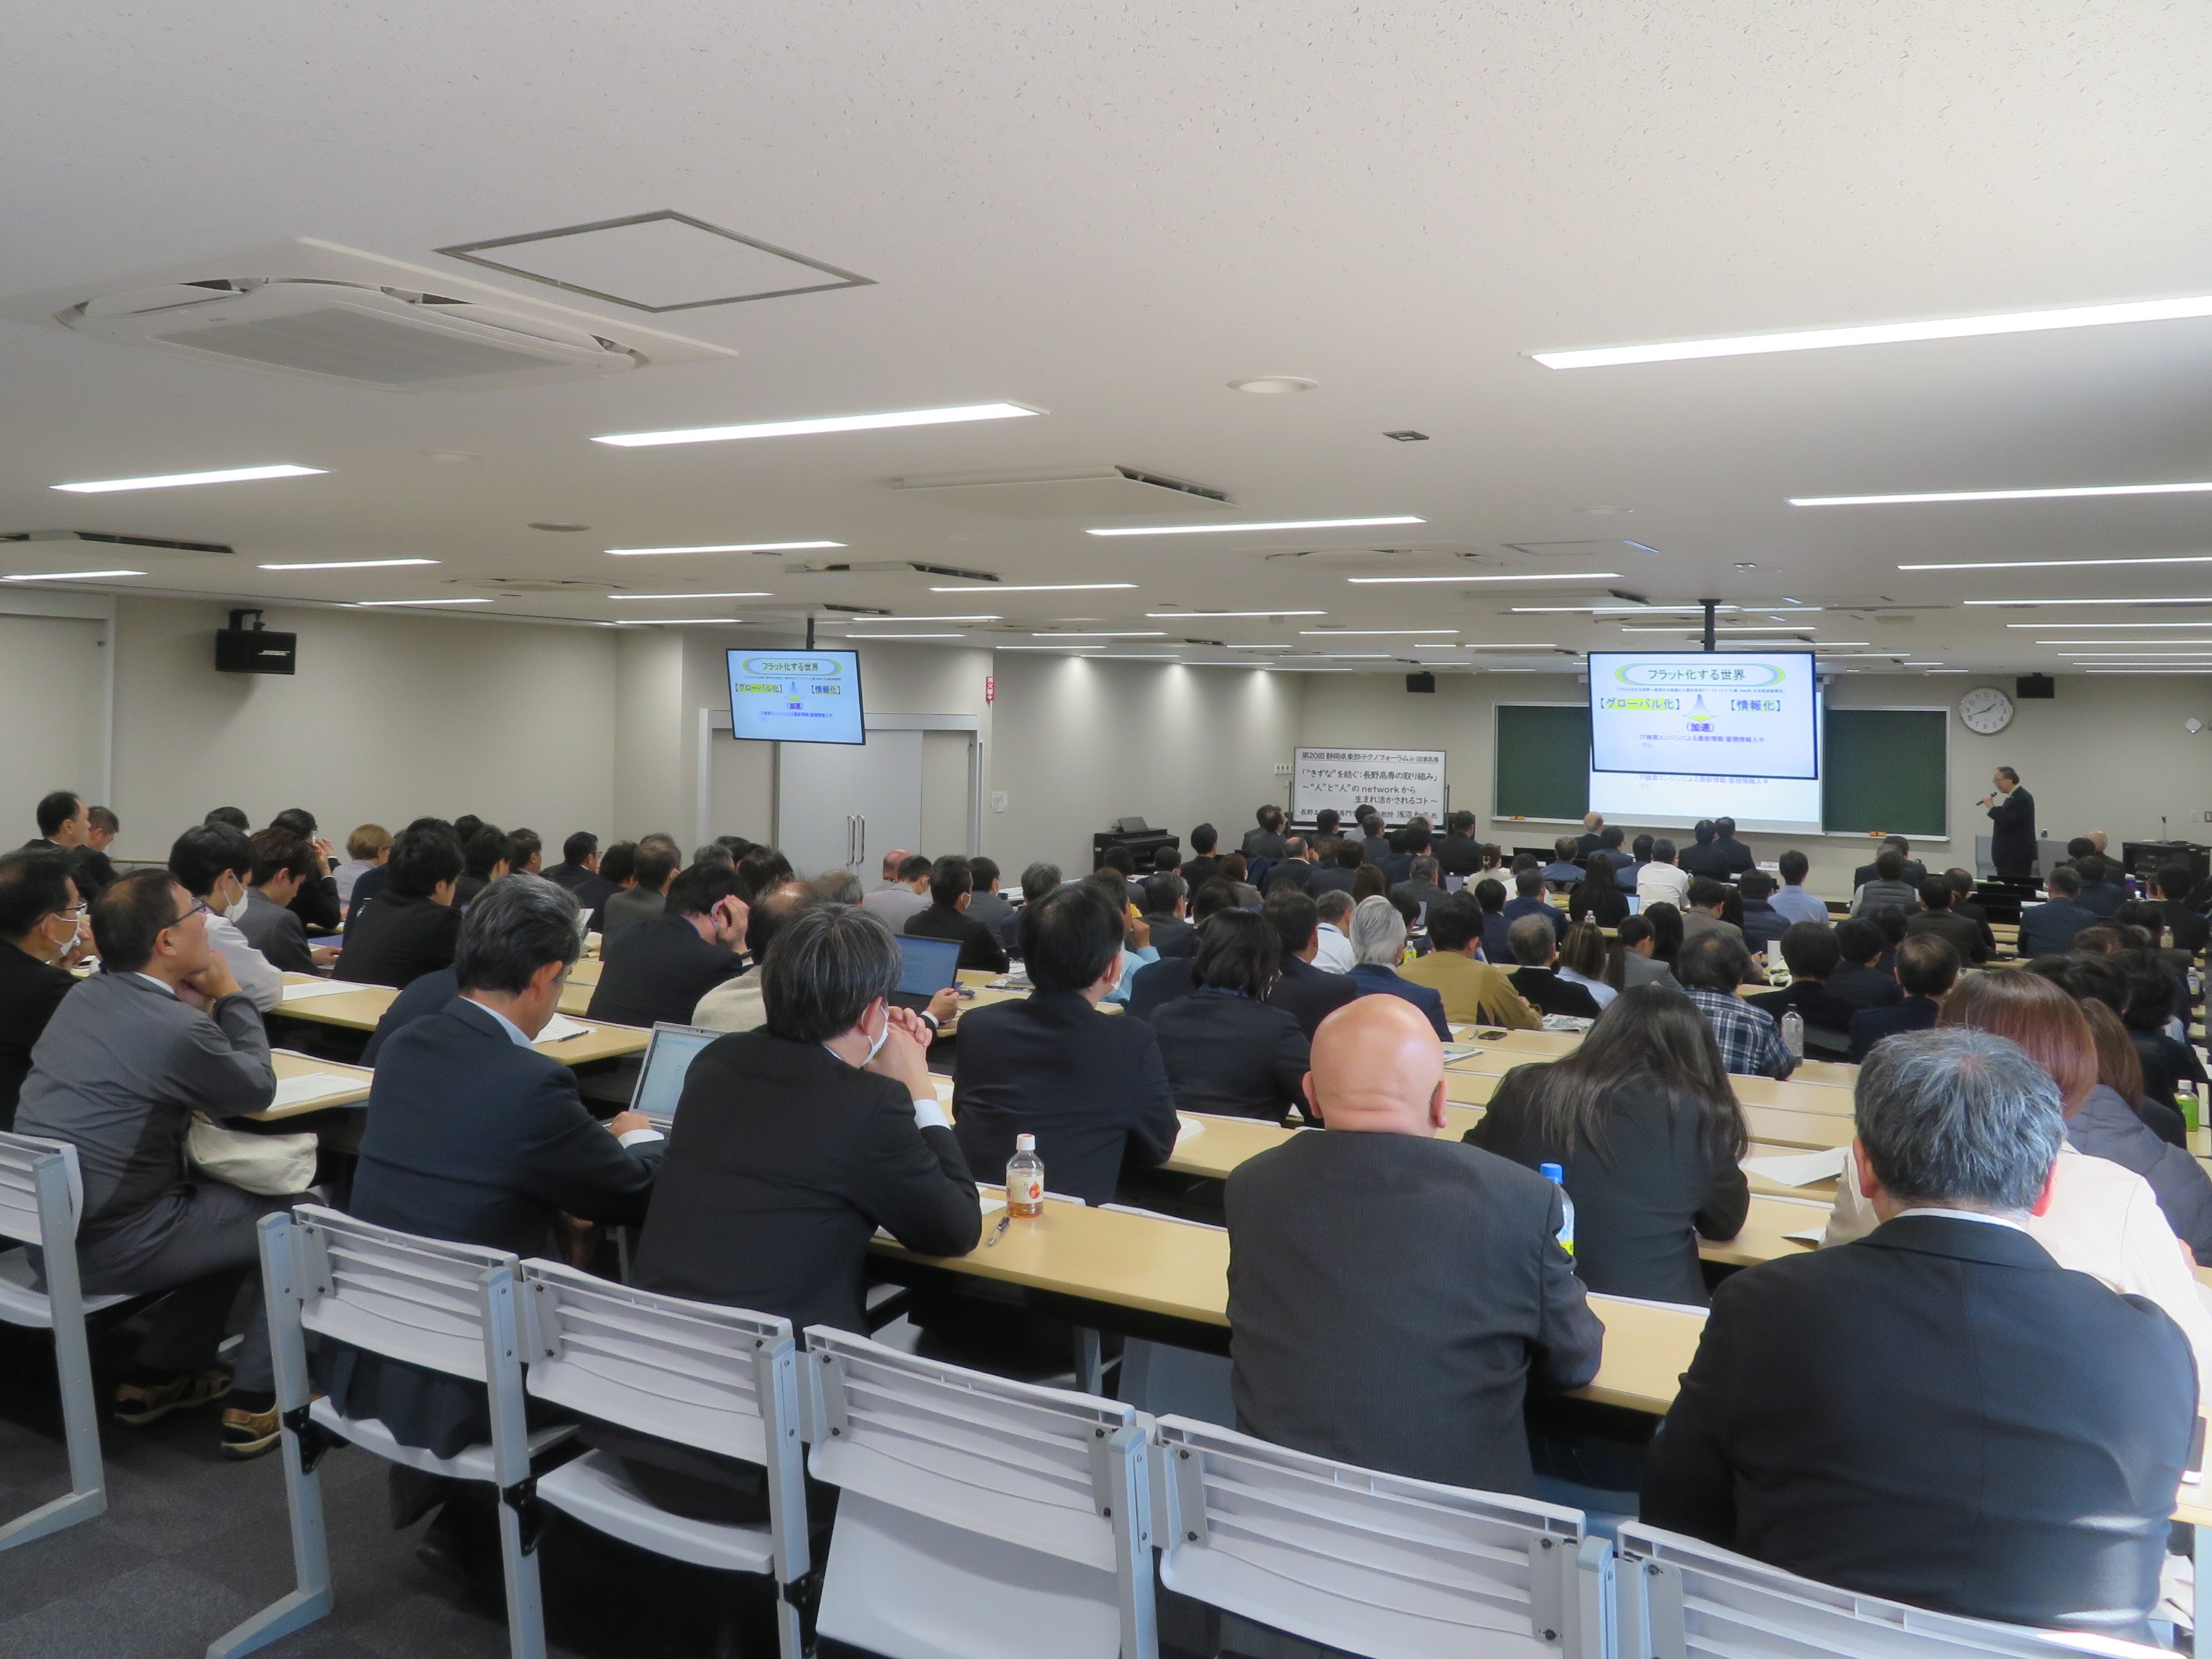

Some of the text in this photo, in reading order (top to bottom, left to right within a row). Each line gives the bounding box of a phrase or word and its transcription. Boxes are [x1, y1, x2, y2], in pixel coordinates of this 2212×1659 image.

[762, 662, 820, 671] フラット化する世界
[1648, 668, 1746, 681] フラット化する世界
[735, 683, 783, 693] 【グローバル化】
[1600, 697, 1680, 711] 【グローバル化】
[1730, 699, 1781, 712] 【情報化】
[1401, 786, 1416, 794] から
